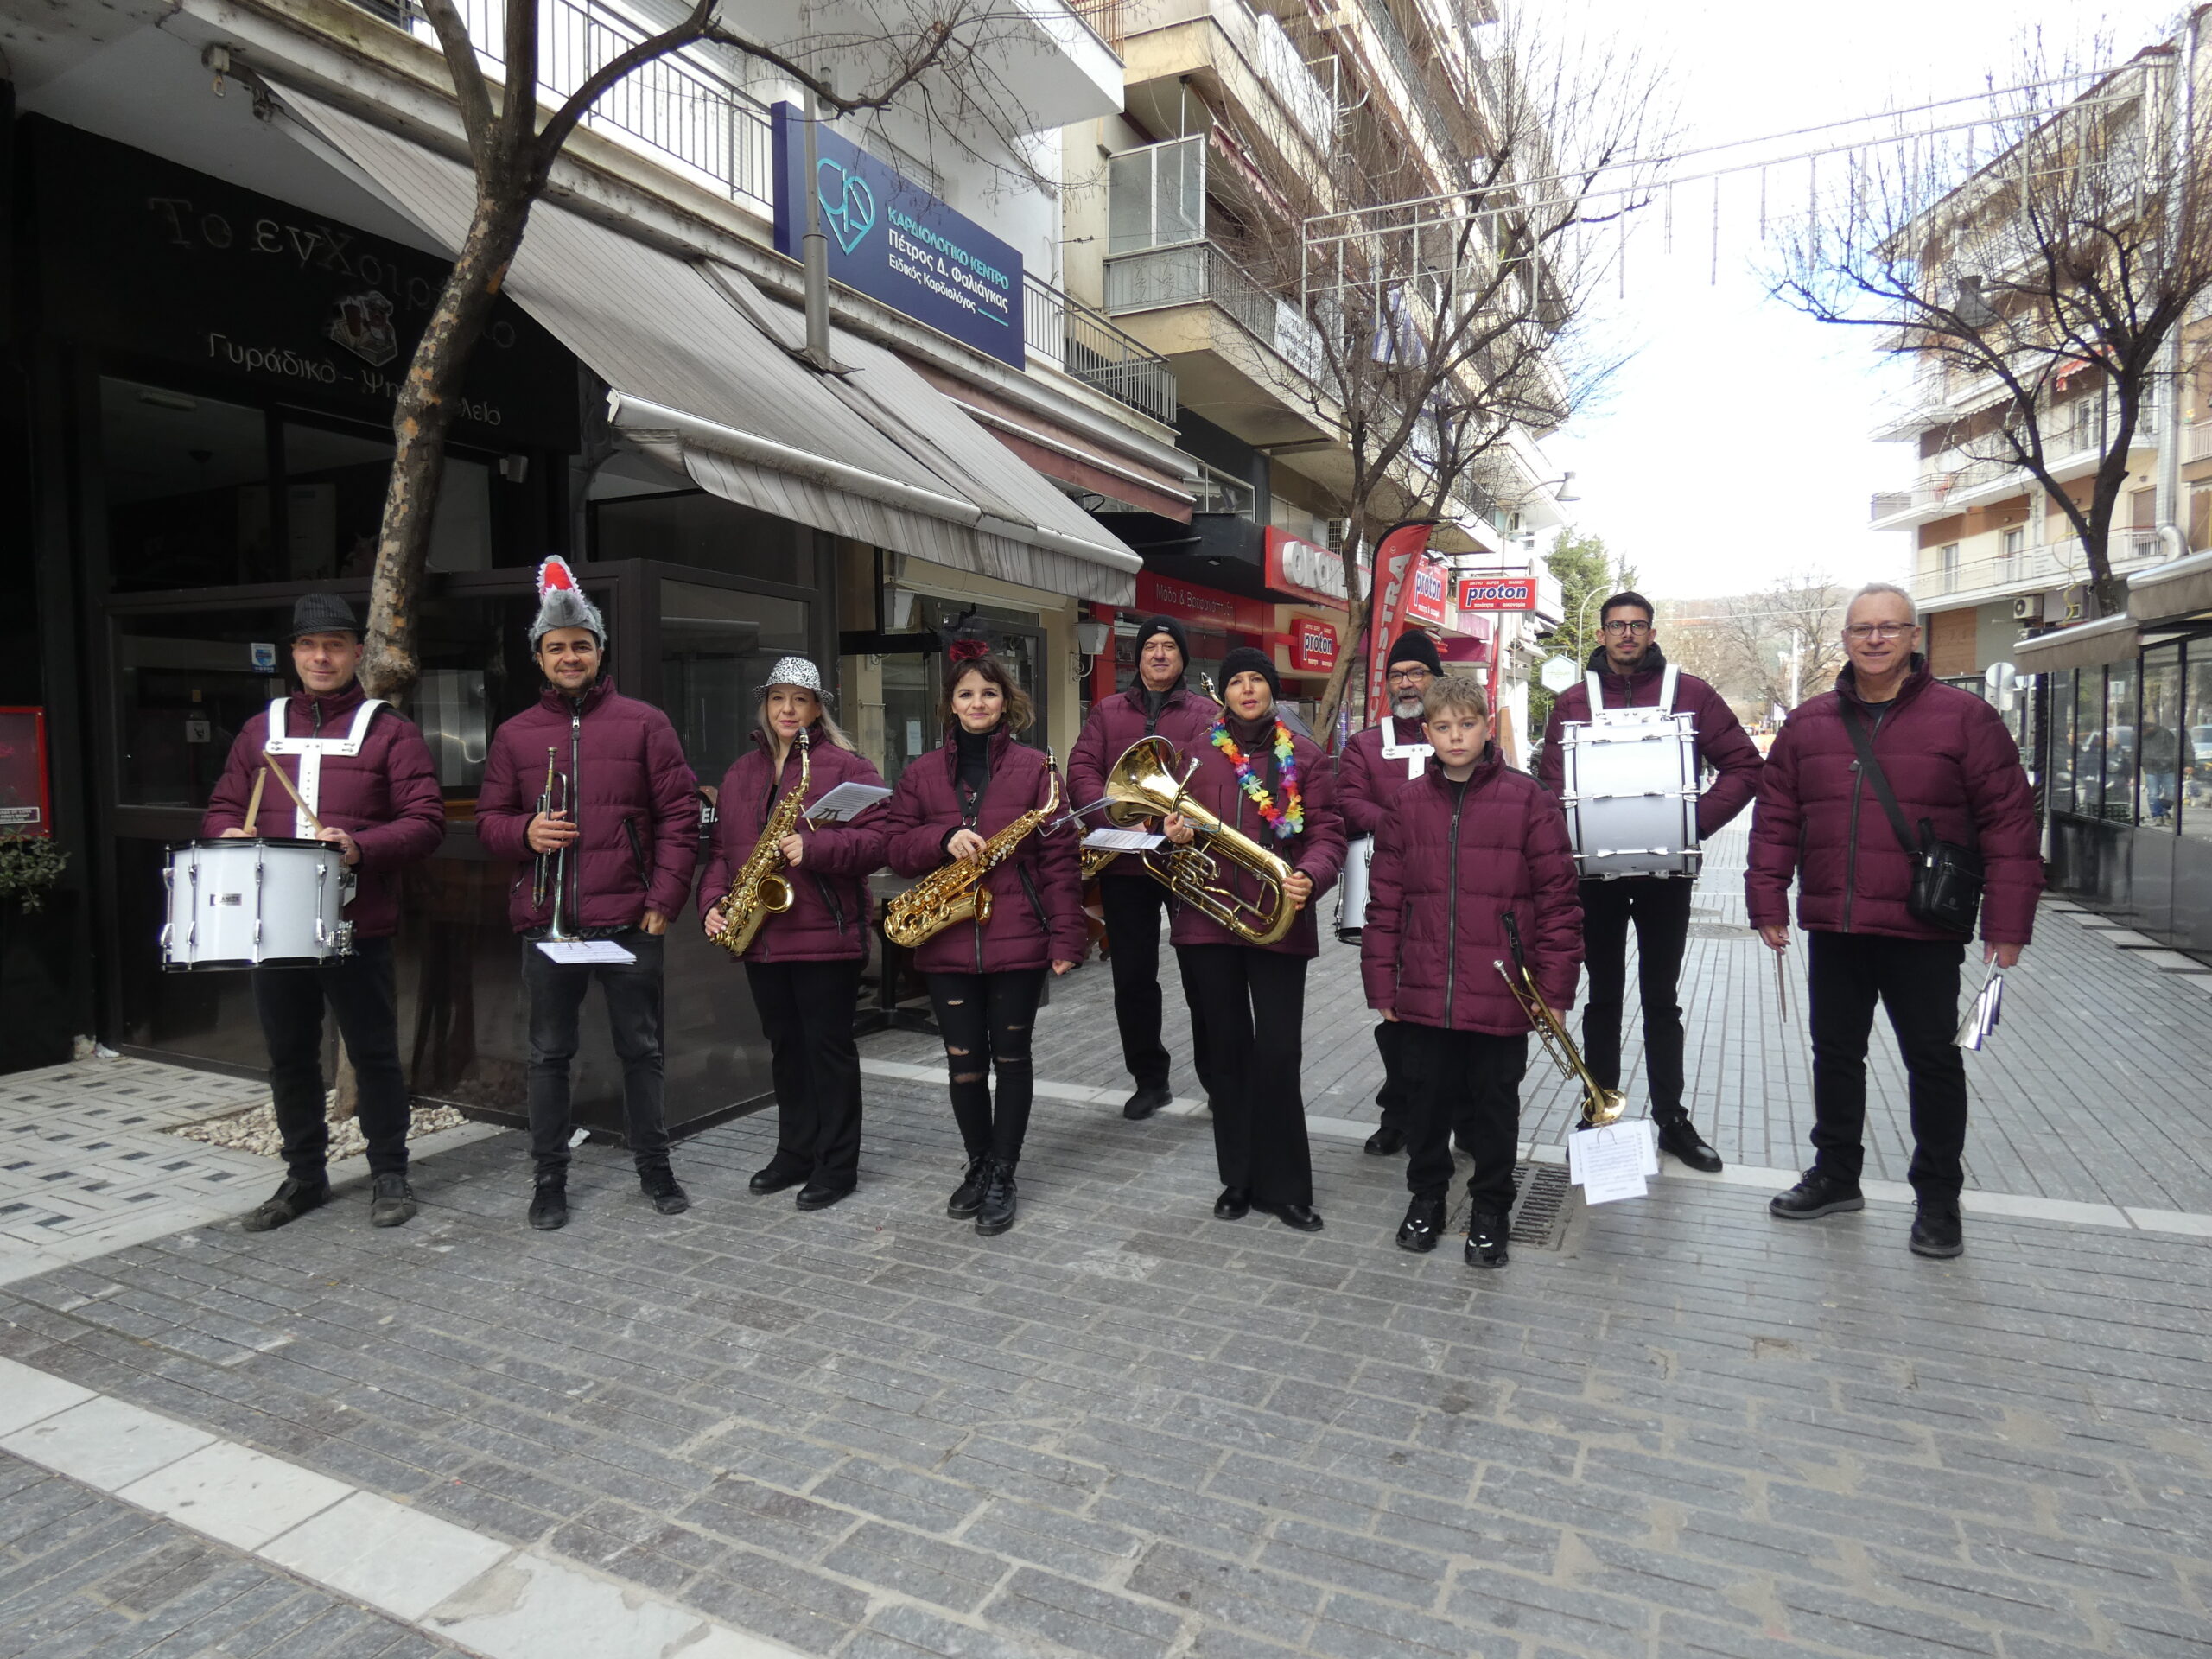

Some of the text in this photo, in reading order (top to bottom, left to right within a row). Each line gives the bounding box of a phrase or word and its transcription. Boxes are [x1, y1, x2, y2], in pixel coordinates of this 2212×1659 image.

[887, 206, 1009, 289] ΚΑΡΔΙΟΛΟΓΙΚΟ ΚΕΝΤΡΟ
[888, 228, 1008, 314] Πέτρος Δ. Φαλιάγκας
[888, 253, 976, 314] Ειδικός Καρδιολόγος
[1179, 588, 1185, 605] &
[1414, 570, 1442, 607] proton
[1465, 582, 1529, 607] proton
[1303, 631, 1333, 661] proton
